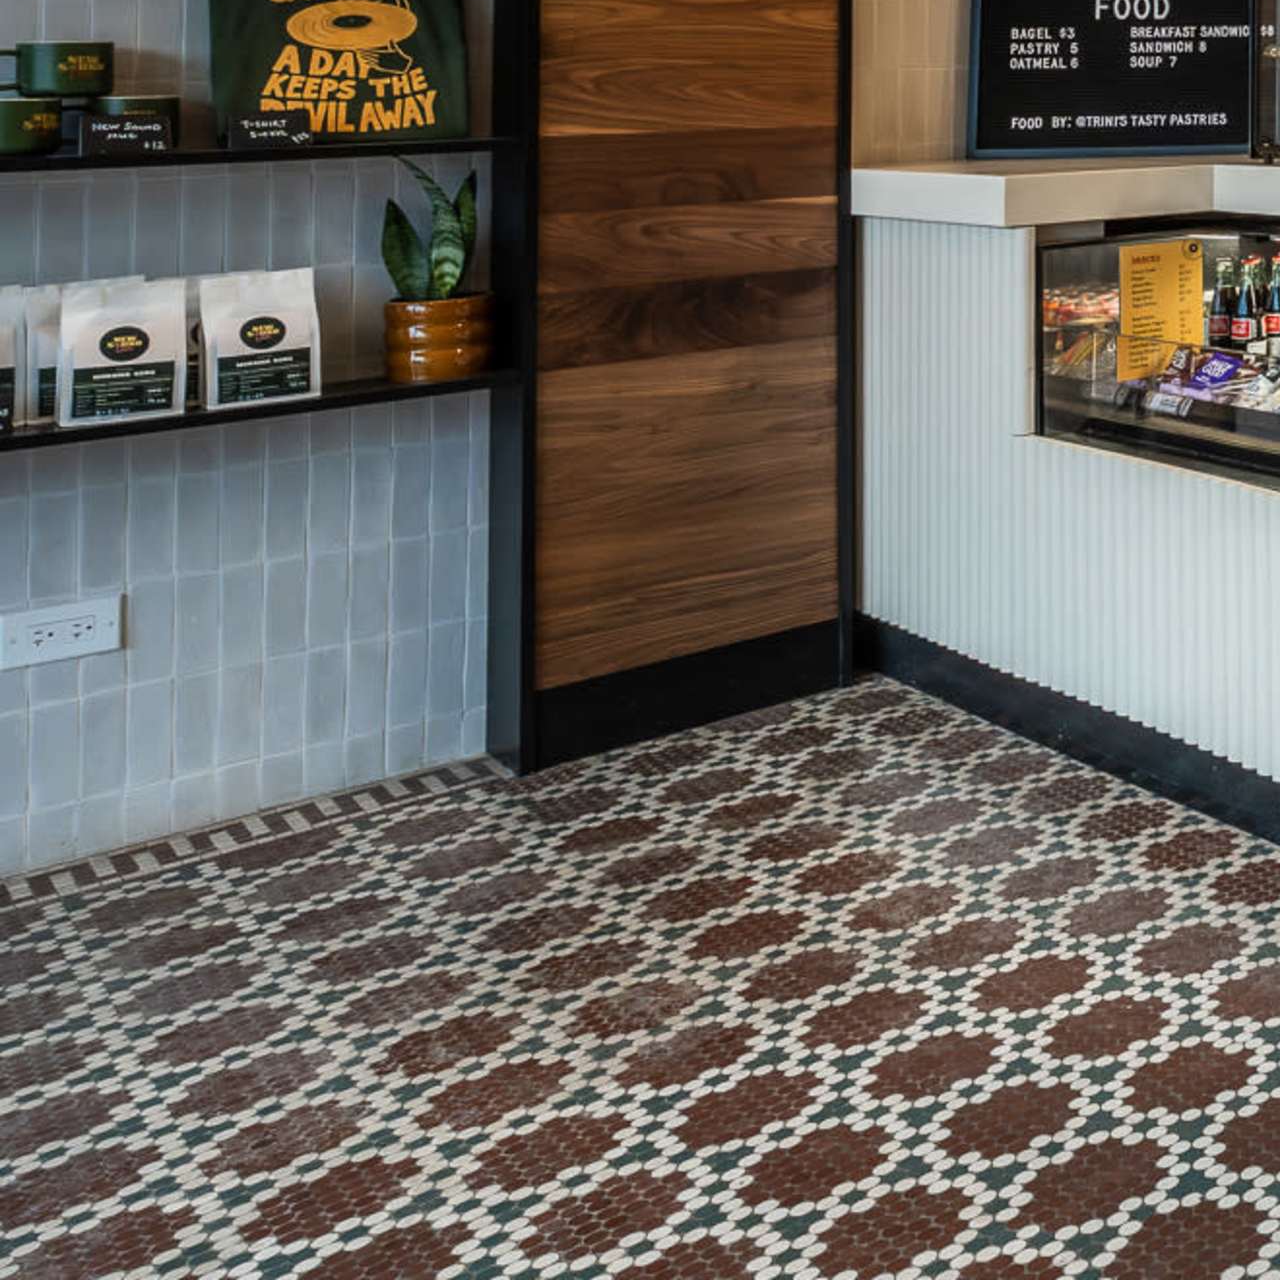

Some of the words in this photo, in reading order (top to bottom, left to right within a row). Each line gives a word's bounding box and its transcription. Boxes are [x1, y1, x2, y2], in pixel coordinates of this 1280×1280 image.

[1010, 27, 1052, 40] BAGEL
[1059, 27, 1076, 39] $3
[1130, 26, 1197, 38] BREAKFAST
[1260, 25, 1275, 37] $8
[1010, 42, 1060, 55] PASTRY
[1070, 42, 1079, 55] 5
[1129, 42, 1193, 54] SANDWICH
[1198, 41, 1207, 54] 8
[272, 44, 301, 74] A
[308, 47, 371, 79] DAY
[1009, 57, 1067, 69] OATMEAL
[1070, 57, 1079, 69] 6
[1129, 56, 1163, 69] SOUP
[1169, 56, 1178, 68] 7
[260, 72, 357, 100] KEEPS
[368, 67, 428, 99] THE
[359, 89, 438, 133] AWAY
[1010, 117, 1043, 130] FOOD
[1052, 116, 1072, 129] BY:
[1131, 114, 1168, 127] TASTY
[1169, 113, 1227, 126] PASTRIES
